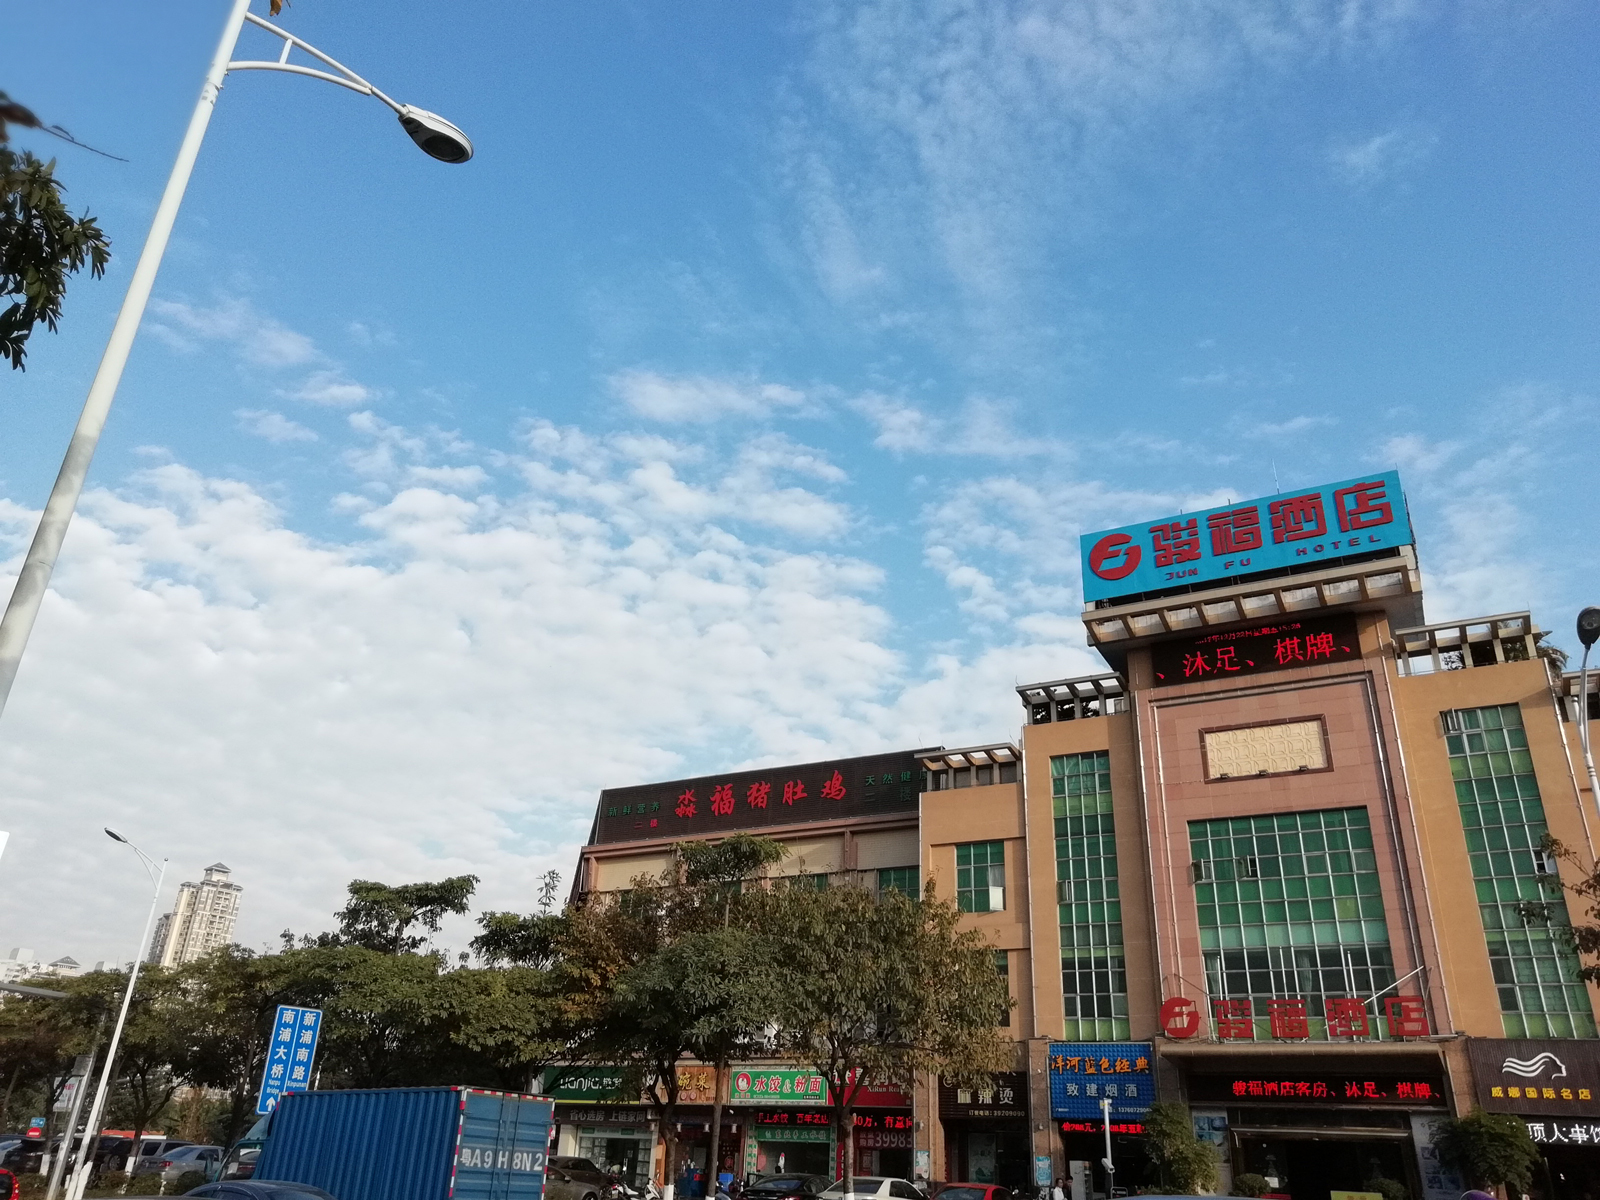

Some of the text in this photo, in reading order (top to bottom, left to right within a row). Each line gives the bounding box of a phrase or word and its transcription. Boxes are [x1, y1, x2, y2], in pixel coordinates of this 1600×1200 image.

[1149, 479, 1394, 568] 骏福酒店
[1165, 534, 1383, 581] JUN FU HOTEL
[607, 801, 661, 817] 新鲜营养
[674, 769, 848, 818] 淼福猪肚鸡
[1213, 996, 1430, 1039] 骏福酒店
[270, 1009, 296, 1079] 南浦大桥
[291, 1011, 317, 1081] 新浦南路
[1051, 1054, 1149, 1074] 洋河蓝色经典
[957, 1087, 1014, 1104] 麻辣烫
[1066, 1083, 1138, 1097] 致建烟酒
[569, 1109, 647, 1123] 省心选房 上链家网
[460, 1147, 544, 1171] 粤A9H8N2
